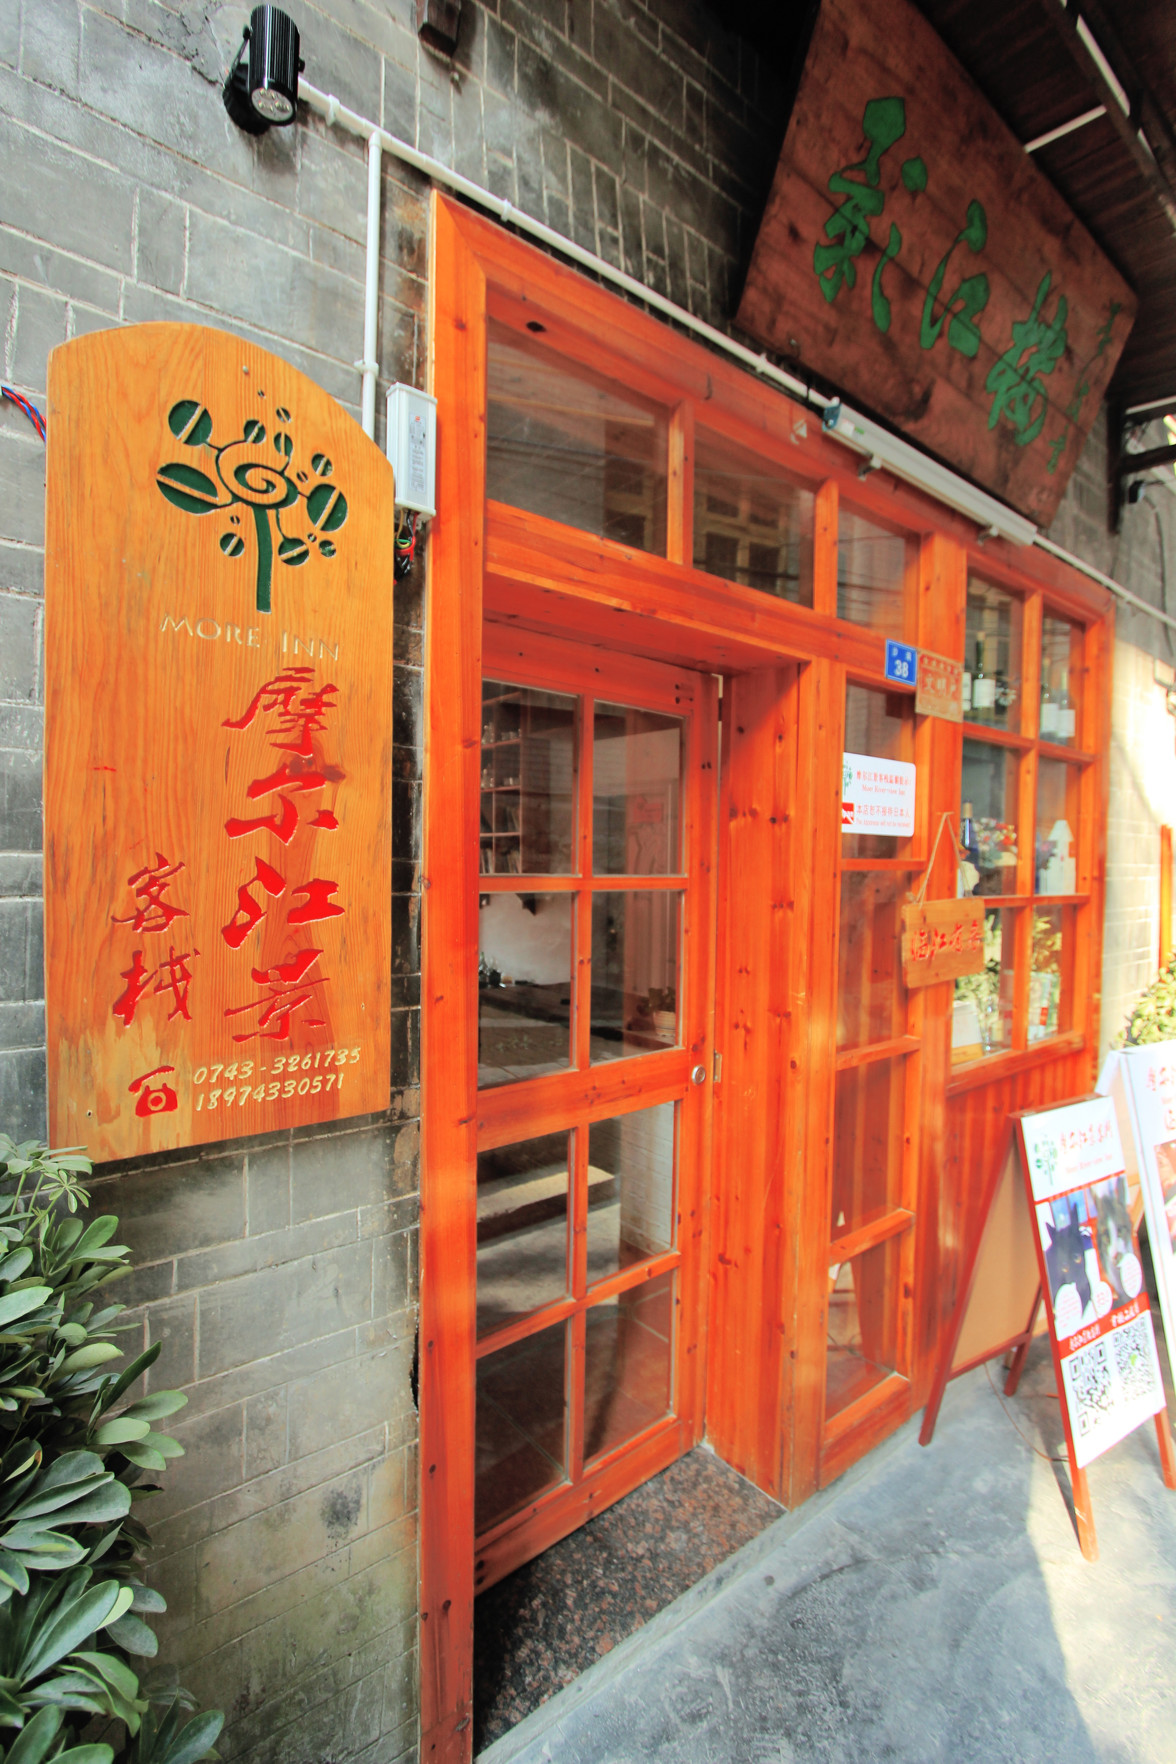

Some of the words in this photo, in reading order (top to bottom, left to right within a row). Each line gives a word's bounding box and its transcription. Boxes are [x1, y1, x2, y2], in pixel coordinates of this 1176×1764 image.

[159, 613, 261, 648] MORE
[281, 629, 339, 661] INN
[894, 659, 909, 678] 38
[111, 852, 200, 1027] 客栈
[195, 1073, 345, 1112] 18974330571
